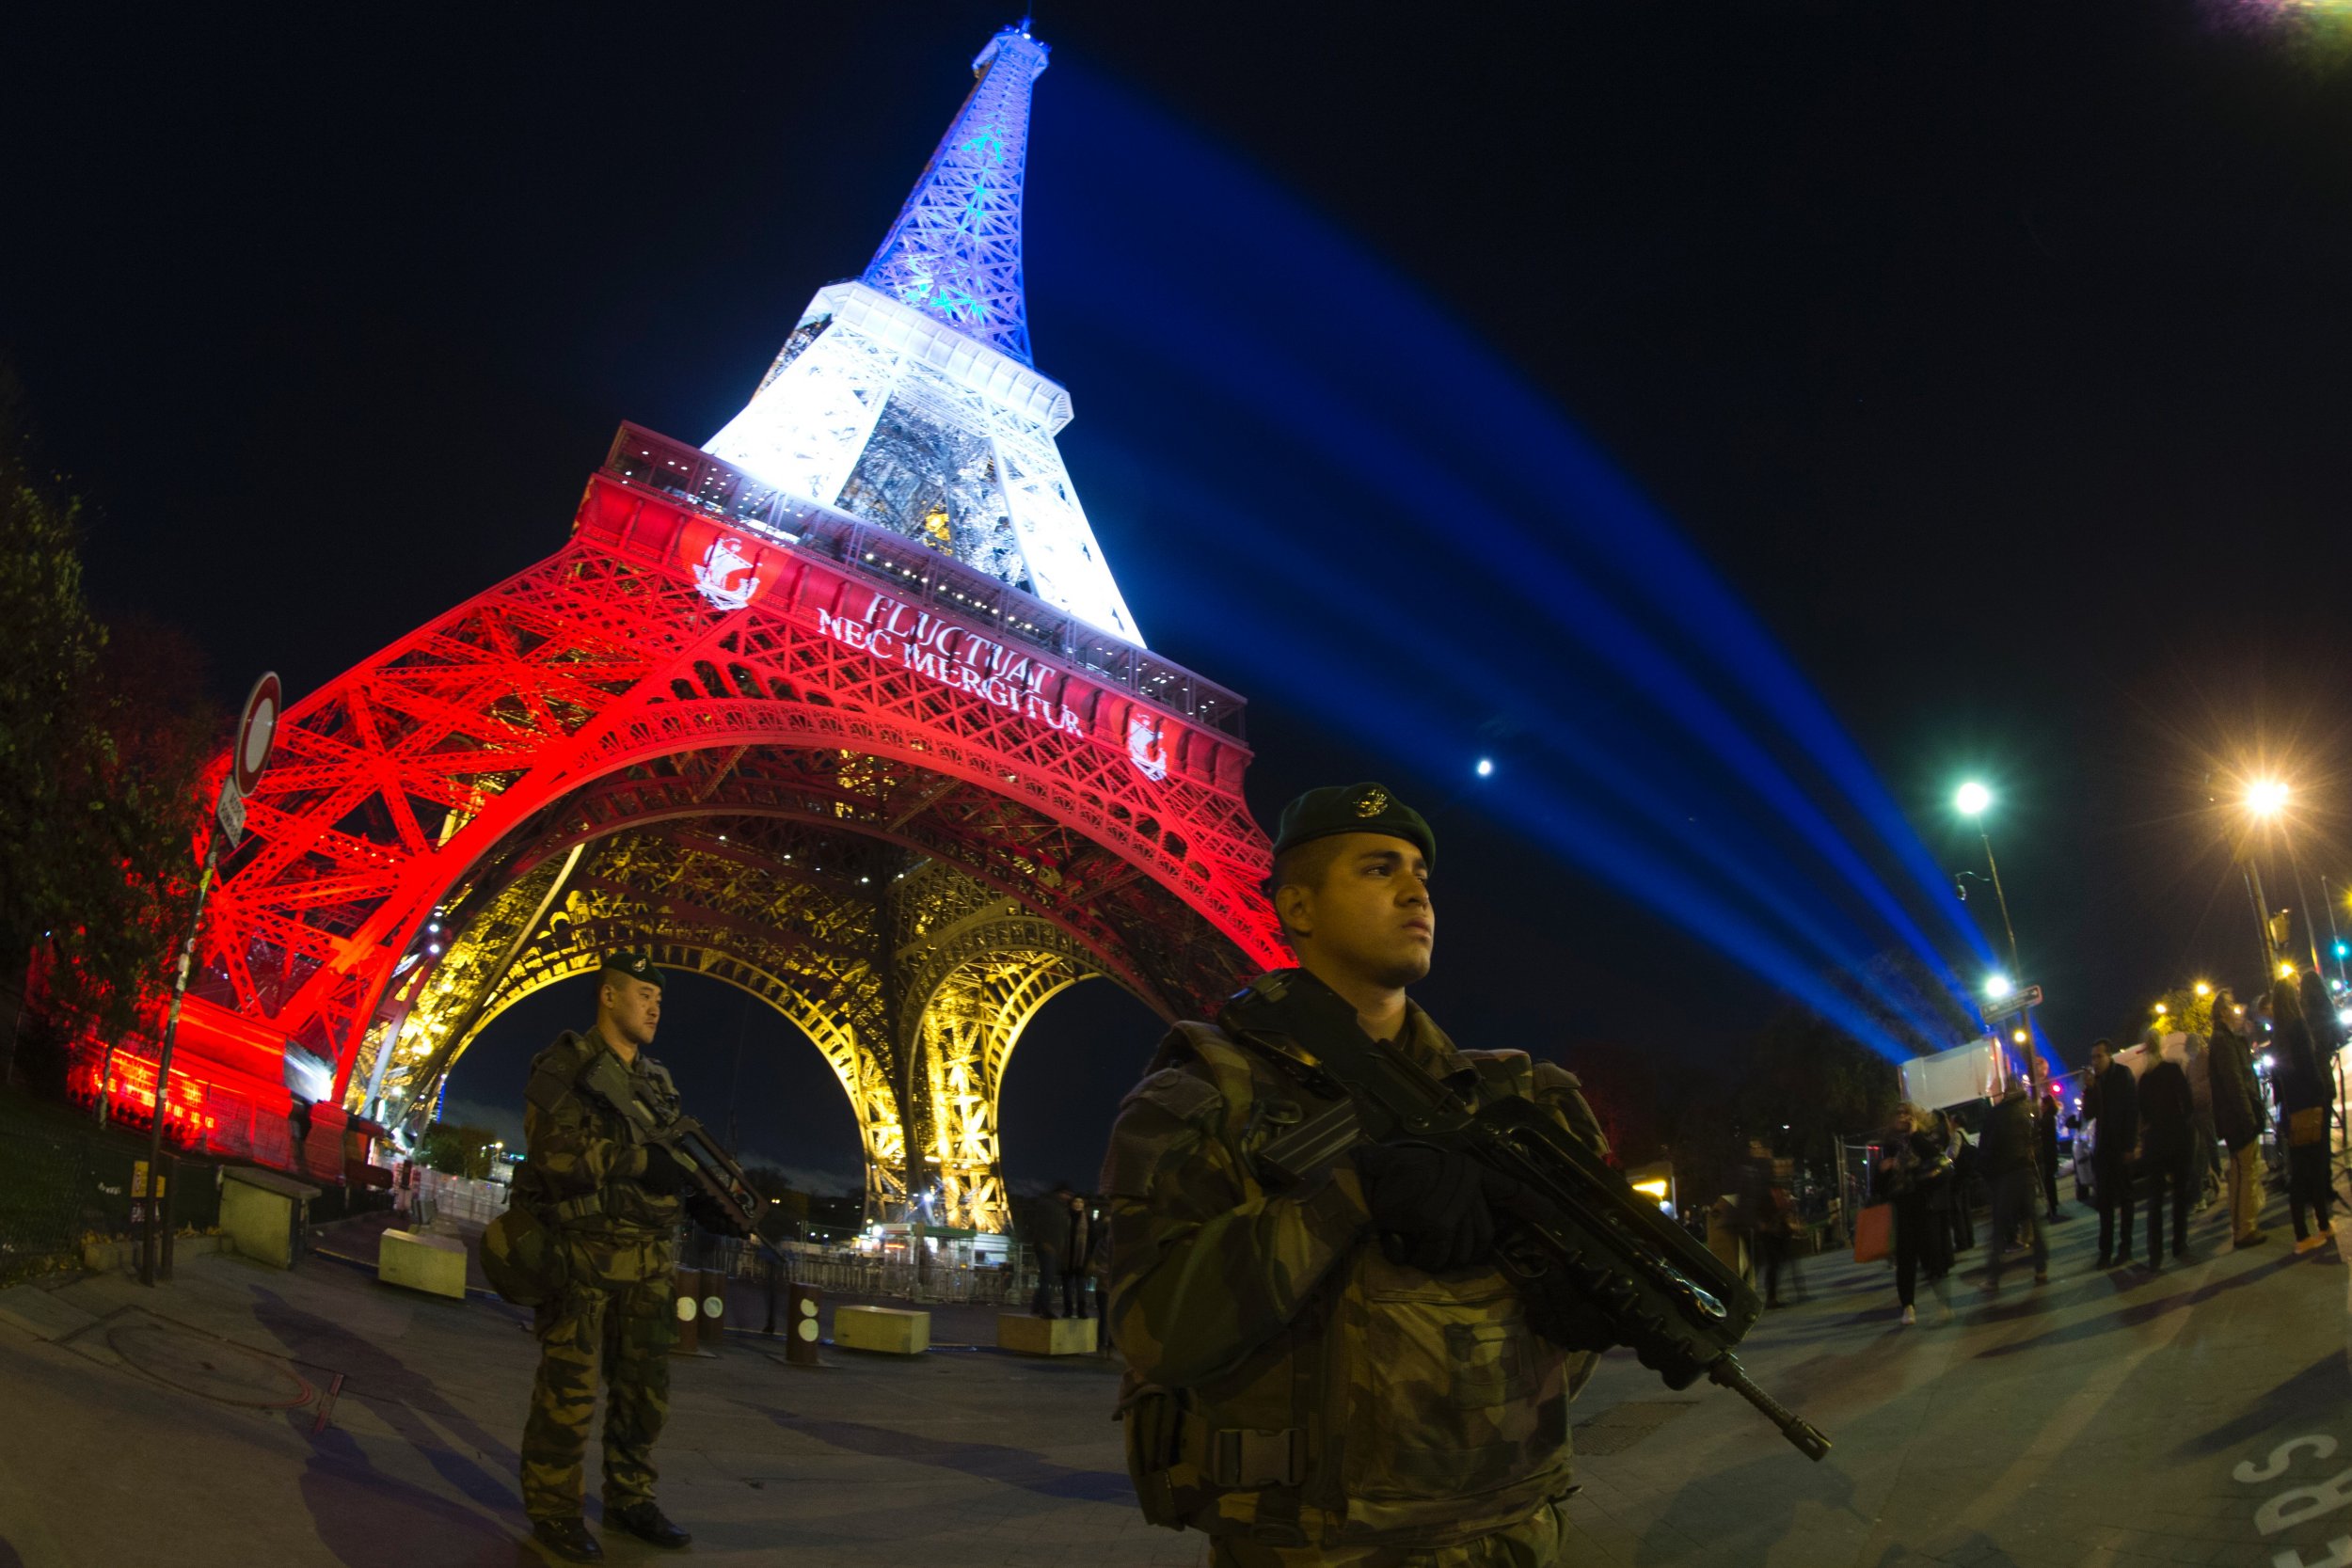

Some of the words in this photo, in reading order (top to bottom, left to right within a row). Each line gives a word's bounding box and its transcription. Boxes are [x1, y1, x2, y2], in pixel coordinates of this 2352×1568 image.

[817, 607, 893, 658] NEC
[901, 641, 1084, 738] MERGITUR
[862, 592, 1056, 695] FLUCTUAT
